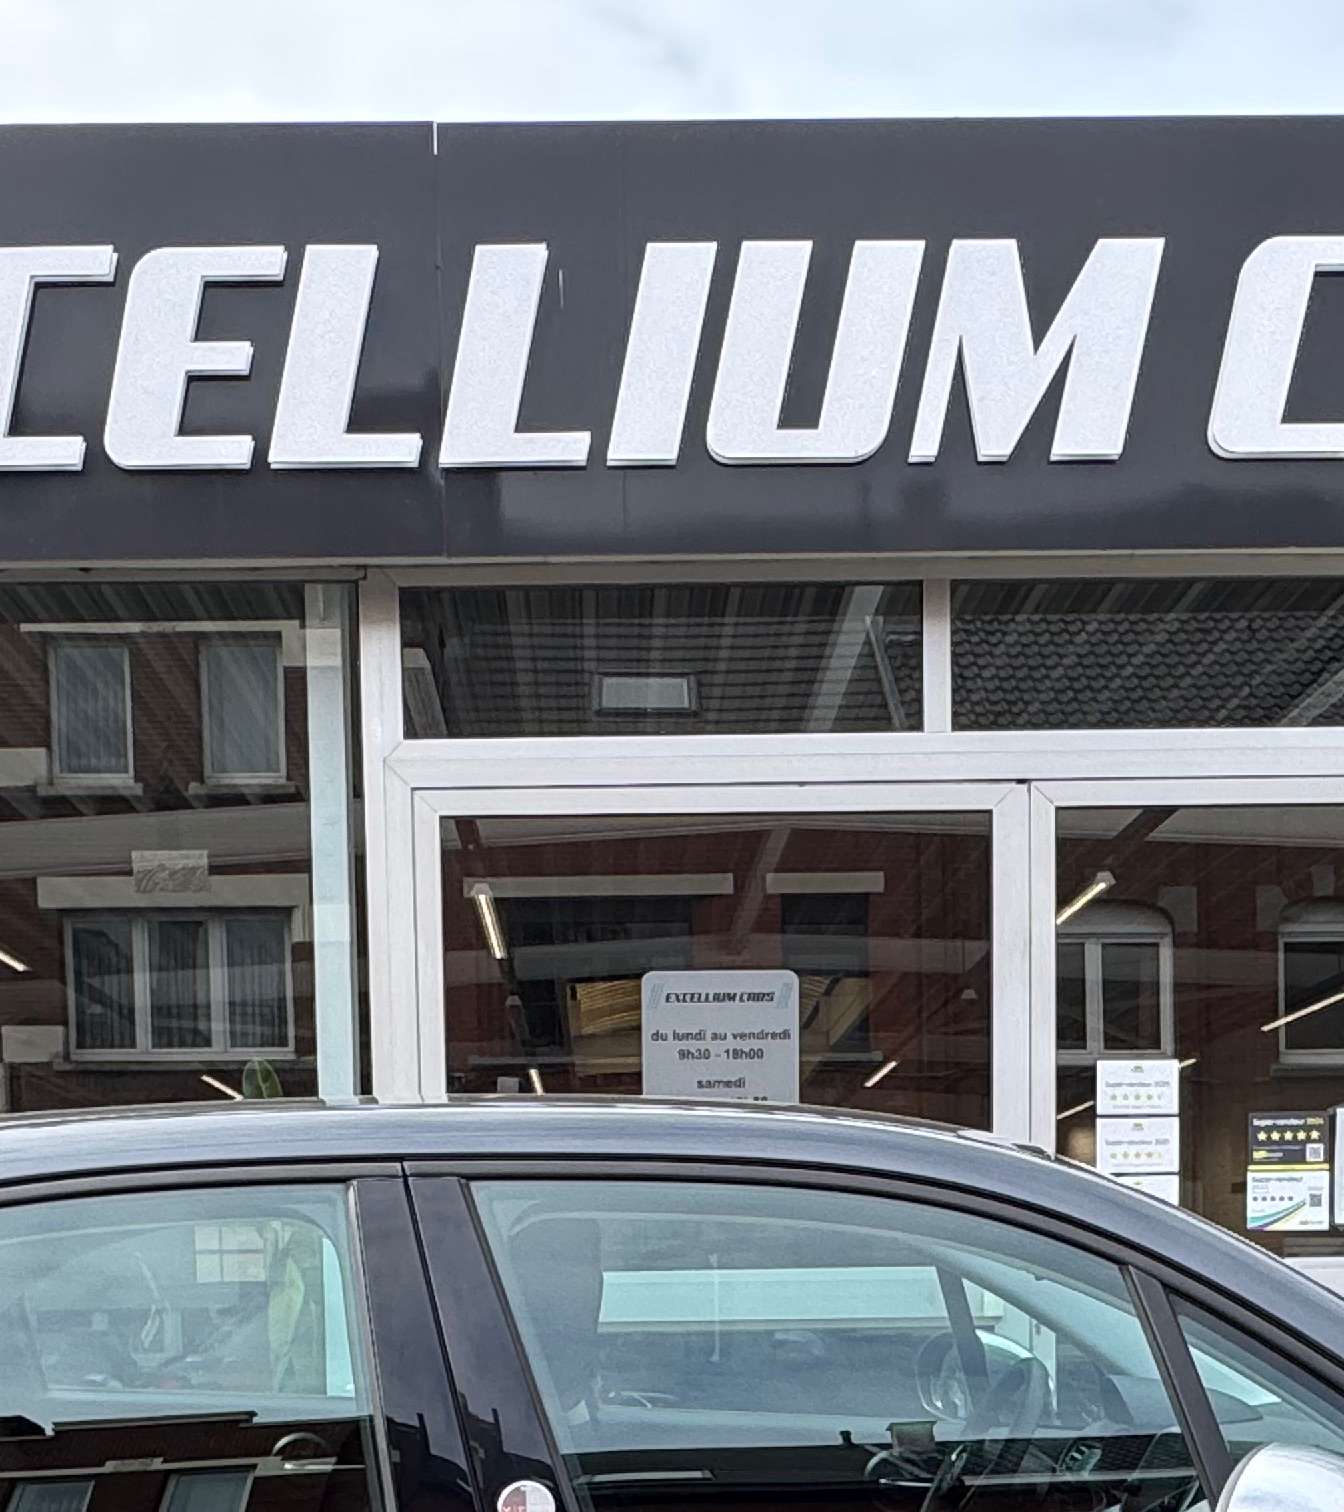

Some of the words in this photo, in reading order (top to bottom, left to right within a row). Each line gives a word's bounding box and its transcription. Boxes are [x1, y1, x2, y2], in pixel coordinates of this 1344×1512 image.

[650, 1029, 669, 1042] du
[672, 1029, 707, 1042] lundi
[710, 1031, 728, 1042] au
[731, 1028, 792, 1042] vendredi
[677, 1048, 712, 1061] 9h30
[695, 1077, 747, 1089] samedi
